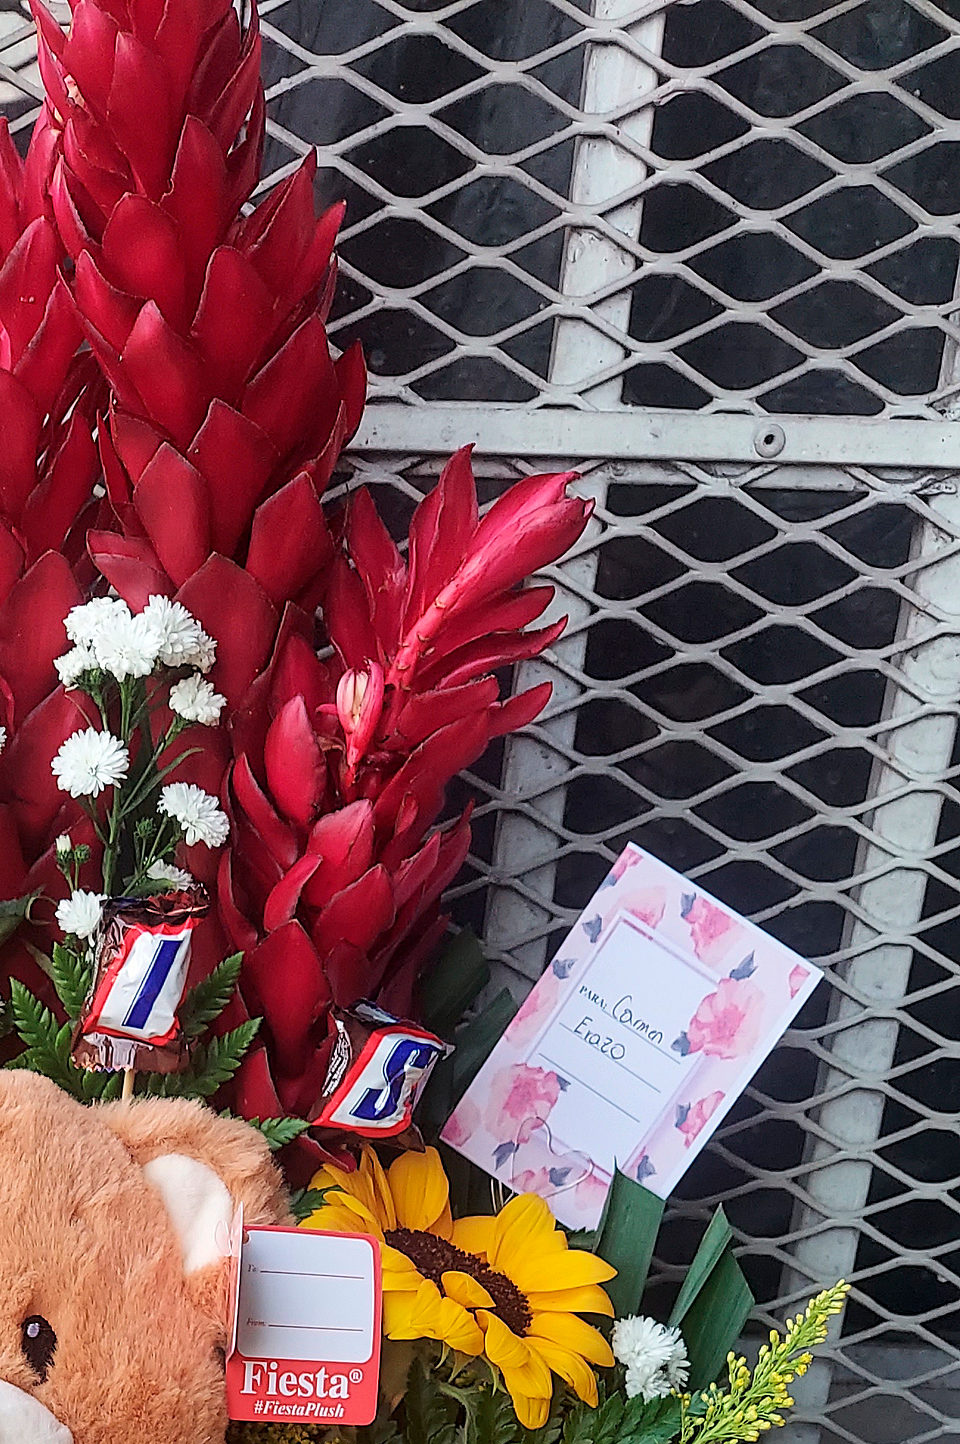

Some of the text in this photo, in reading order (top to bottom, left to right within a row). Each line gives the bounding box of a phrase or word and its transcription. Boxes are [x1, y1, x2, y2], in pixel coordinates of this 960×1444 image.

[579, 984, 608, 1010] PARA:
[611, 994, 663, 1045] Carmen
[349, 1038, 440, 1121] S
[253, 1400, 345, 1418] #FiestaPlush
